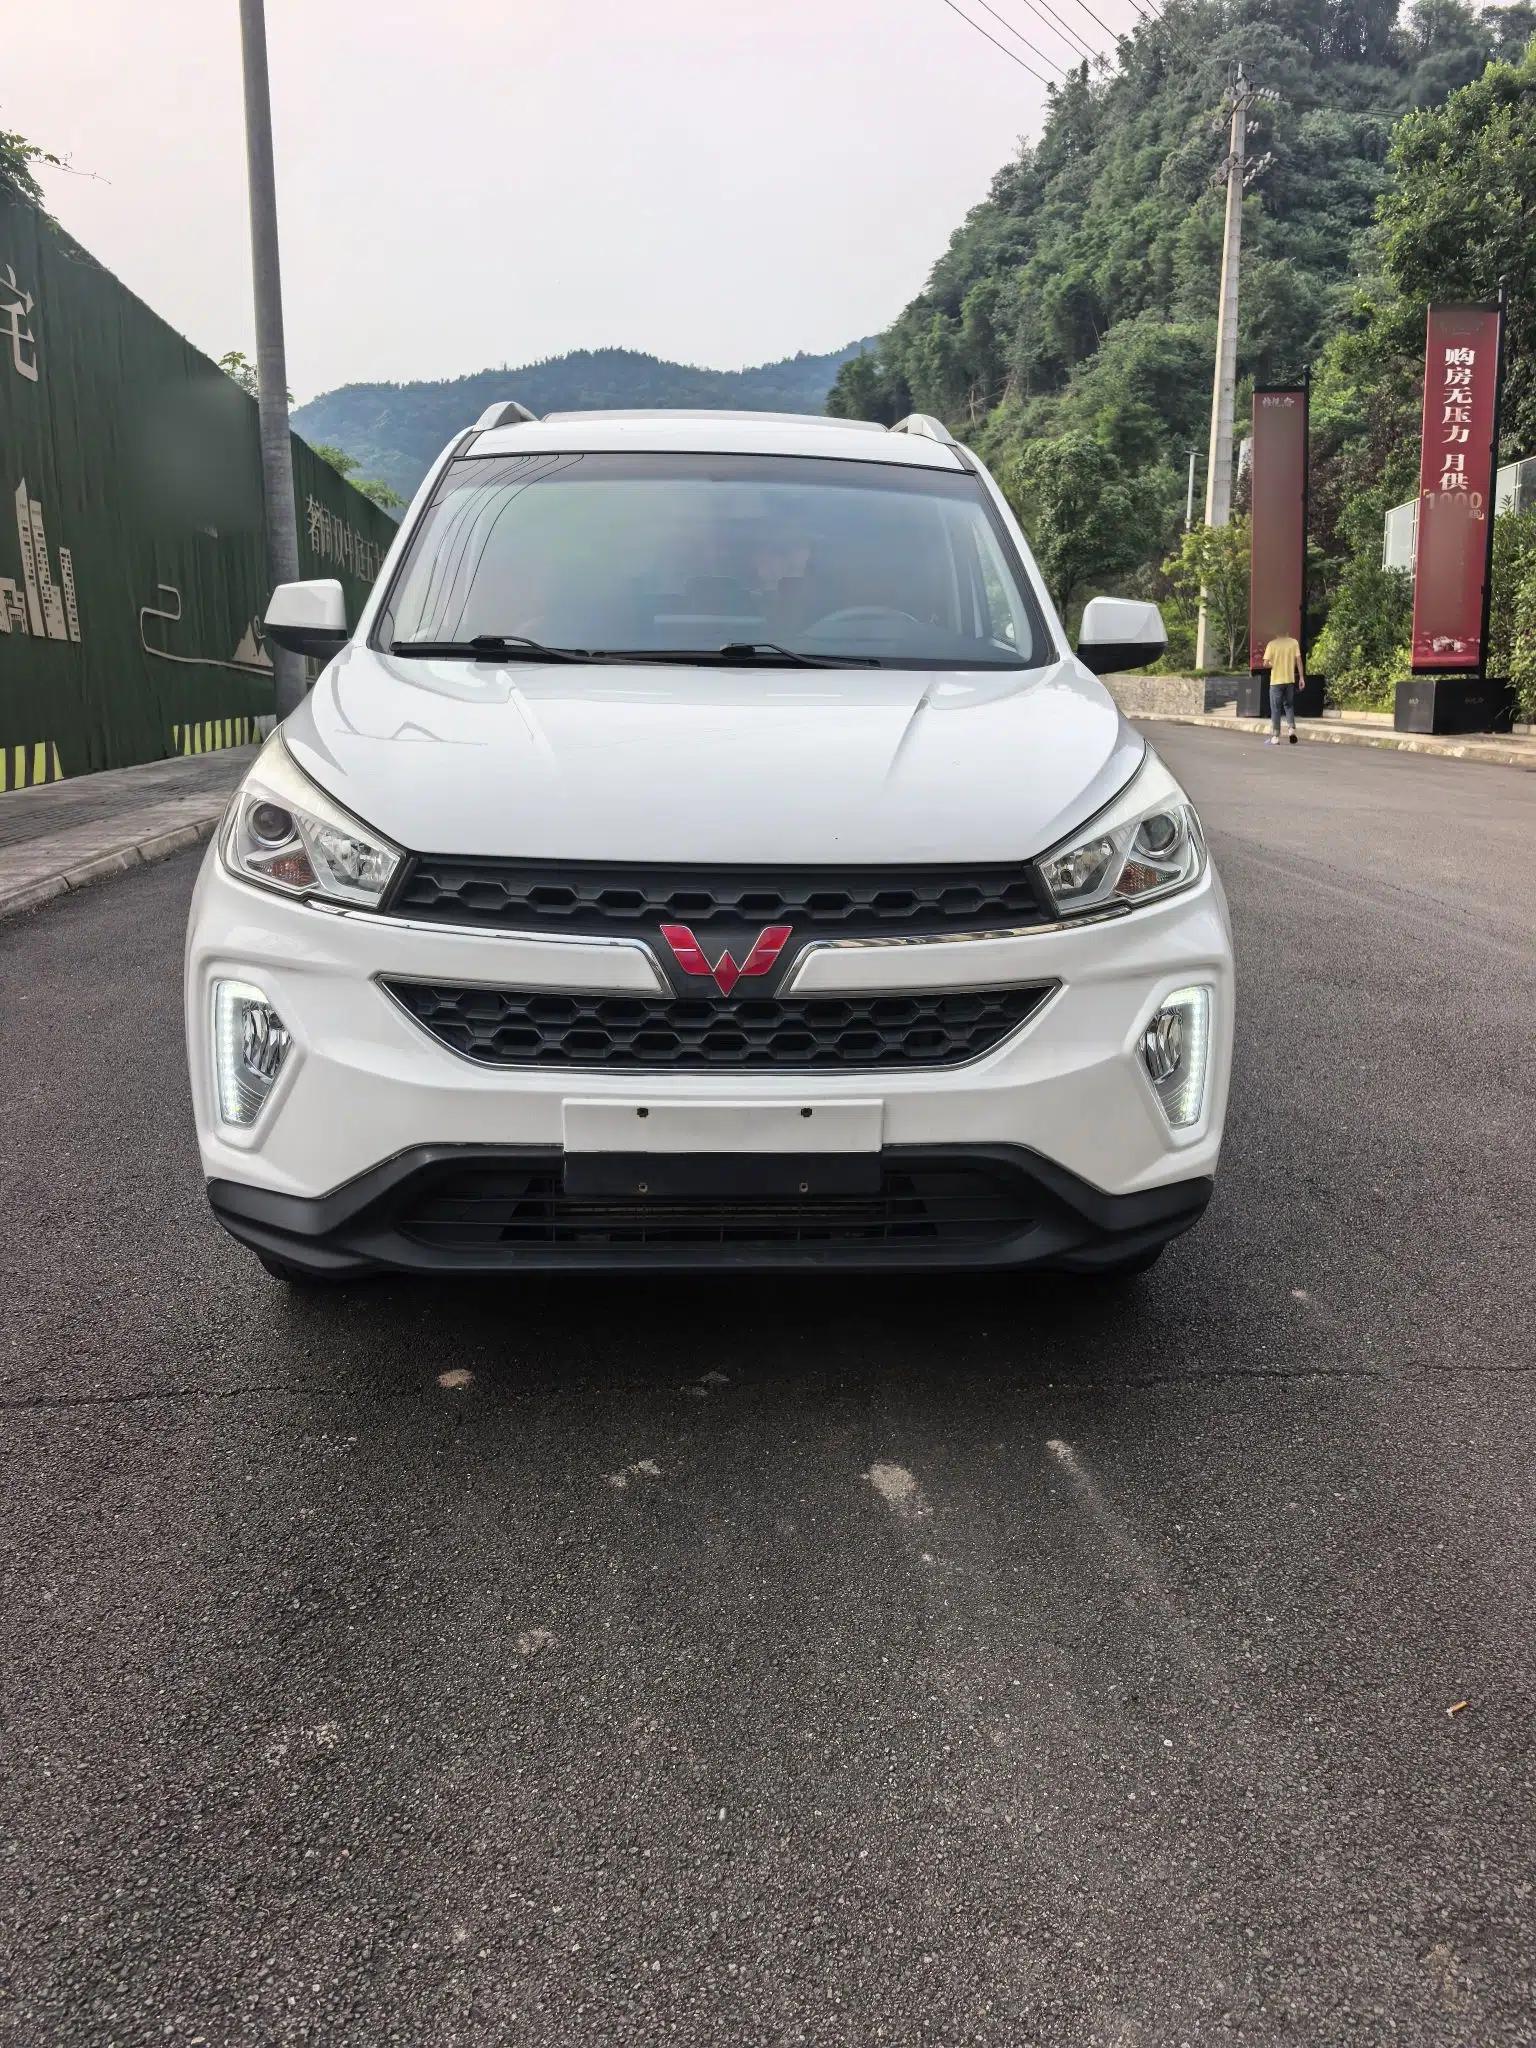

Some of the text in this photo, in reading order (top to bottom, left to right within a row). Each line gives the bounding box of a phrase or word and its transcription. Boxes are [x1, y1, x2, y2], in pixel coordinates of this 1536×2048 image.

[1441, 347, 1476, 444] 购房无压力
[1438, 453, 1469, 490] 月供
